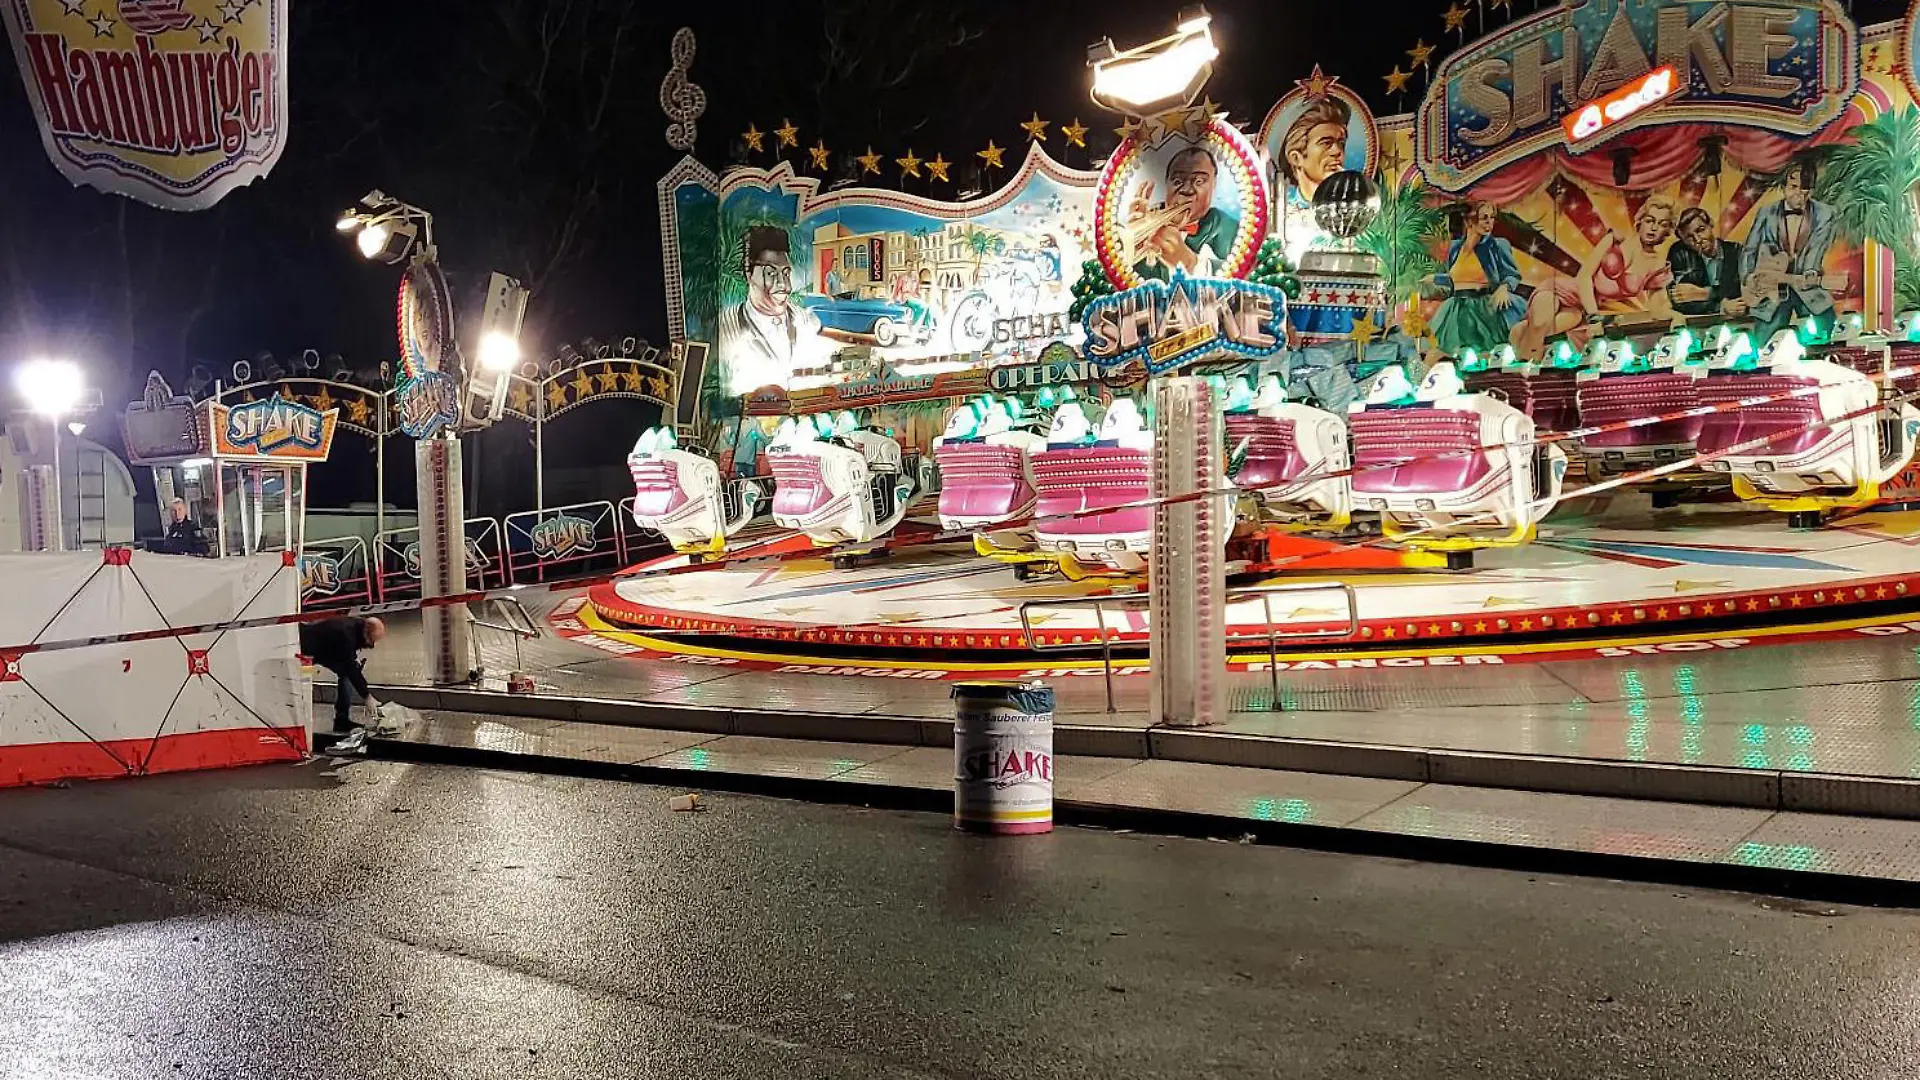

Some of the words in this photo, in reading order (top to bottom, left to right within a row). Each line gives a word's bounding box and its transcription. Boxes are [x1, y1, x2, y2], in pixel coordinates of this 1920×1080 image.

[1457, 1, 1803, 147] SHAKE
[24, 32, 277, 155] Hamburger
[1088, 282, 1278, 355] SHAKE
[232, 406, 318, 443] SHAKE
[535, 521, 593, 551] SHAKE
[1247, 655, 1505, 672] DANGER
[1595, 638, 1750, 657] STOP
[773, 665, 949, 680] DANGER
[964, 748, 1052, 782] SHAKE
